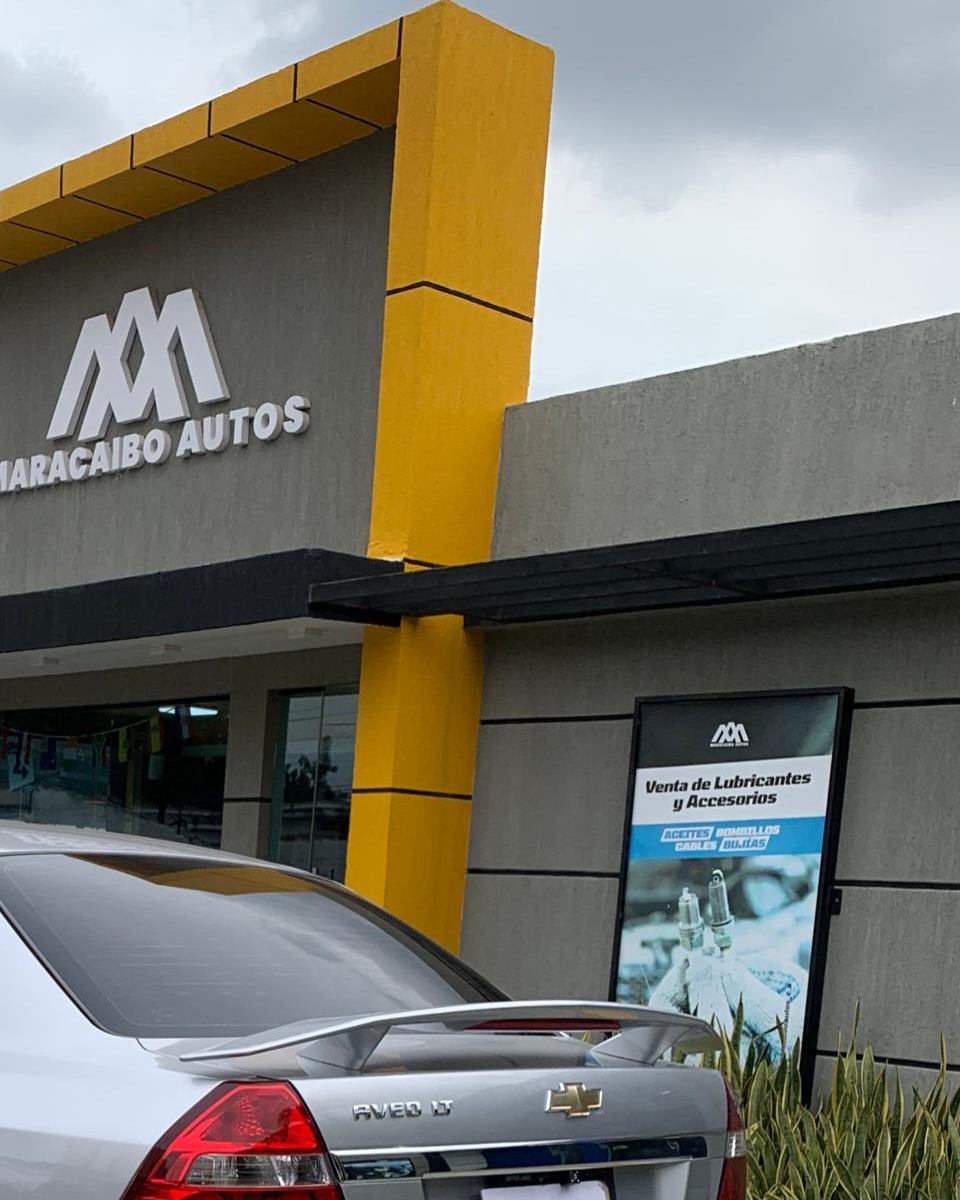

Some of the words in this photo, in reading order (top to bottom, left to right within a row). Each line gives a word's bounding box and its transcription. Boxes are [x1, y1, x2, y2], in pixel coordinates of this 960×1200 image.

[176, 395, 311, 458] AUTOS
[645, 779, 688, 794] Venta
[691, 777, 711, 791] de
[714, 772, 812, 790] Lubricantes
[672, 798, 683, 812] y
[686, 791, 777, 809] Accesorios
[663, 828, 711, 840] ACEITES
[352, 1100, 422, 1121] AVEO
[431, 1099, 453, 1117] LT
